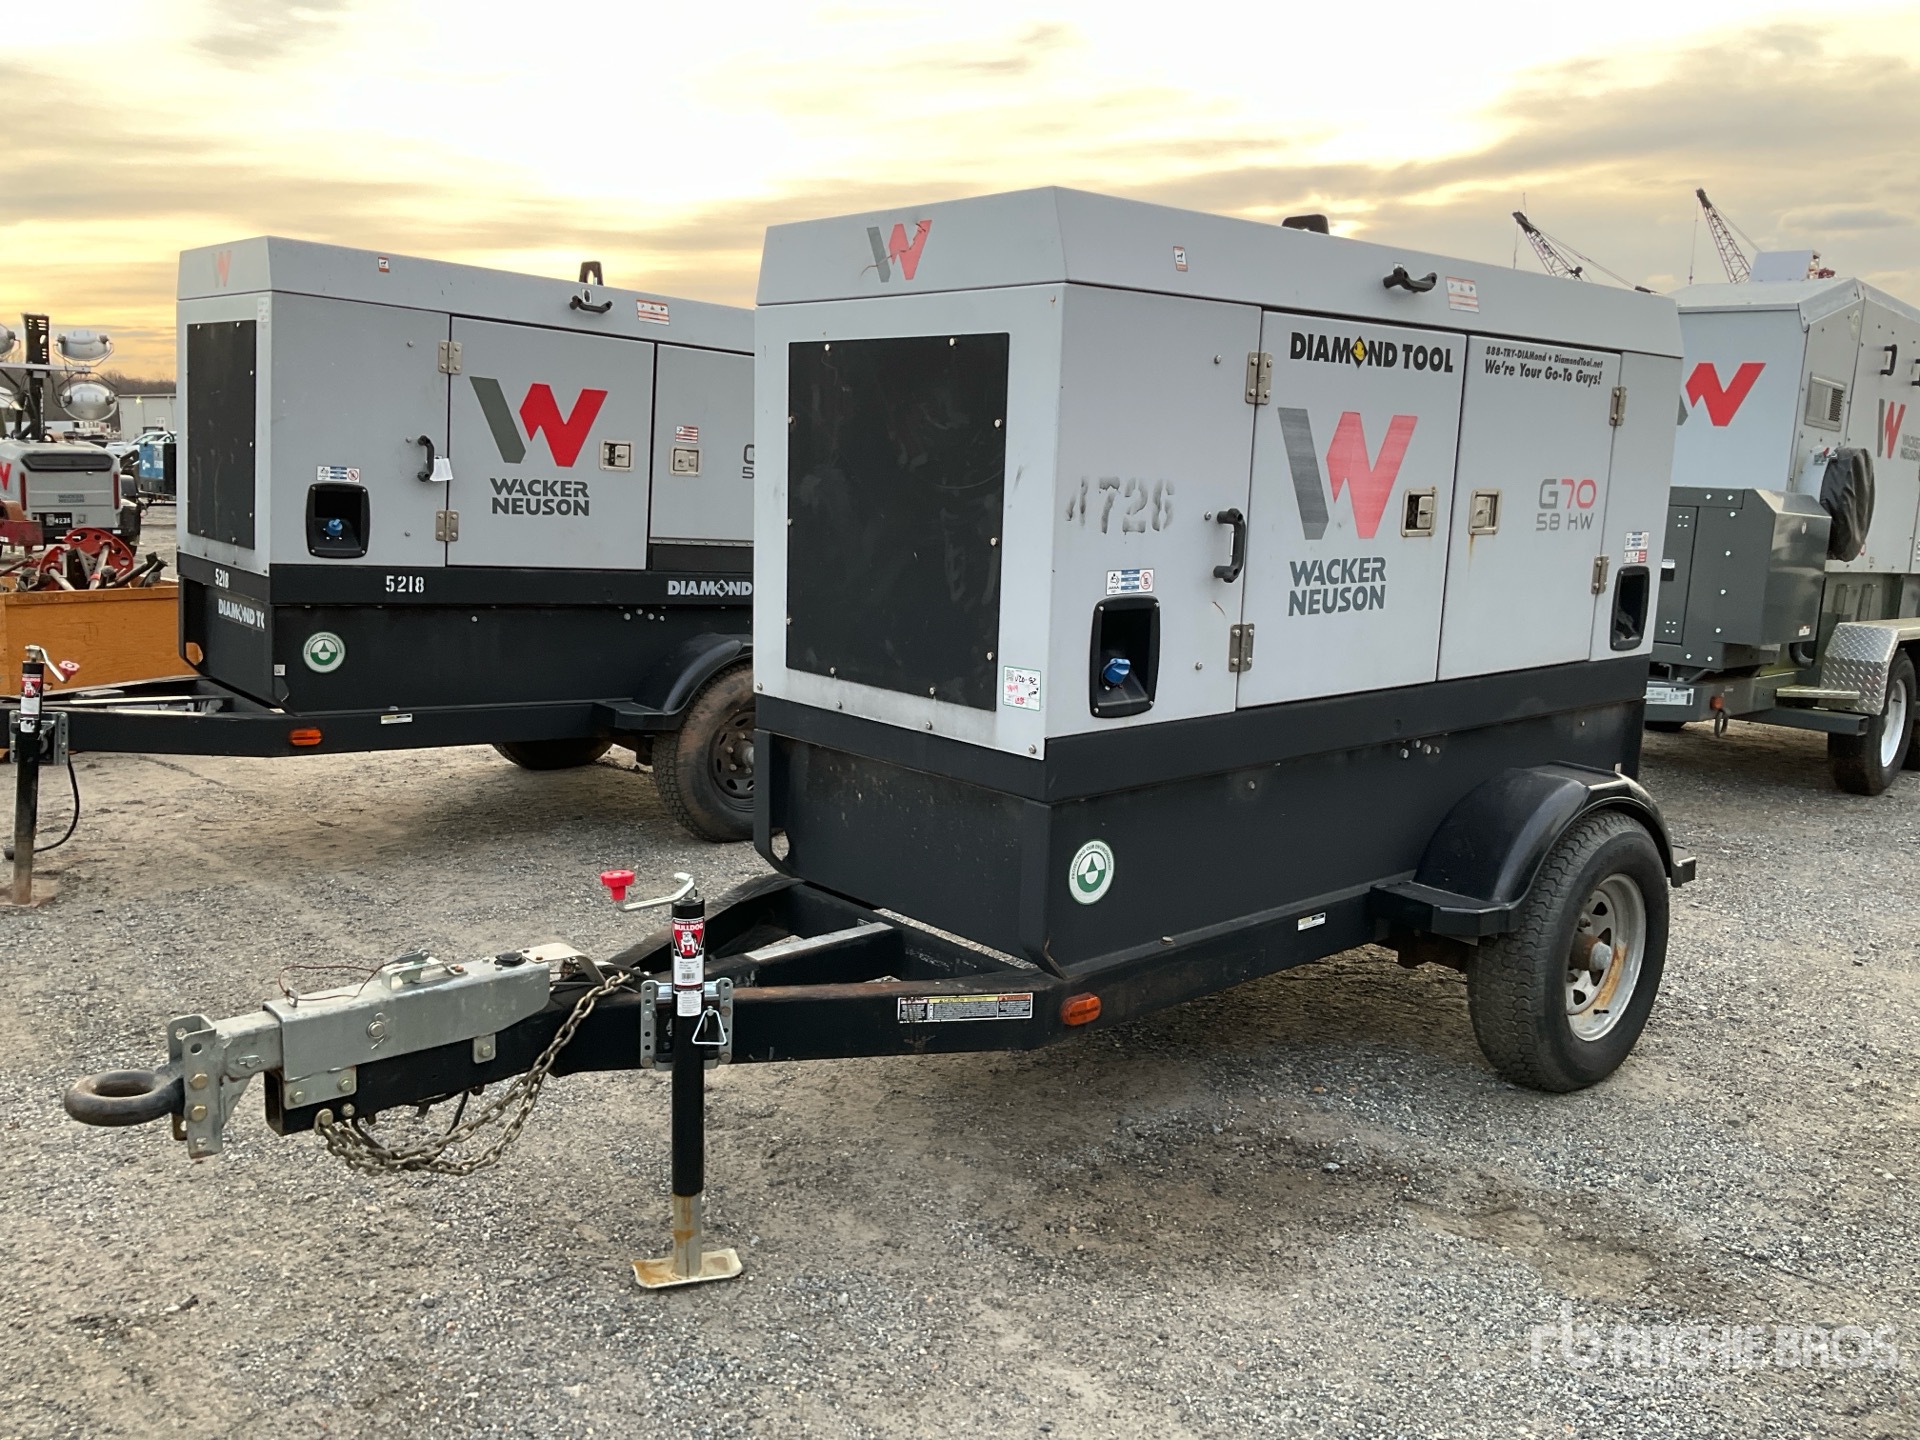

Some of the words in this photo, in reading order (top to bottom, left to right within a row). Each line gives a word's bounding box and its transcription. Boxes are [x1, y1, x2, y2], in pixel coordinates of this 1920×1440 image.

[1290, 331, 1398, 369] DIAMOND
[1402, 343, 1454, 373] TOOL
[1485, 359, 1515, 376] We're
[1520, 363, 1542, 379] Your
[1545, 366, 1572, 382] Go-To
[1576, 369, 1602, 388] Guys!
[489, 478, 589, 498] WACKER
[1539, 478, 1597, 510] G70
[491, 497, 590, 516] NEUSON
[1535, 512, 1561, 531] 58
[215, 568, 229, 589] 5218
[1289, 557, 1386, 587] WACKER
[386, 575, 425, 593] 5218
[1288, 585, 1386, 616] NEUSON
[674, 922, 704, 931] BULLDOG
